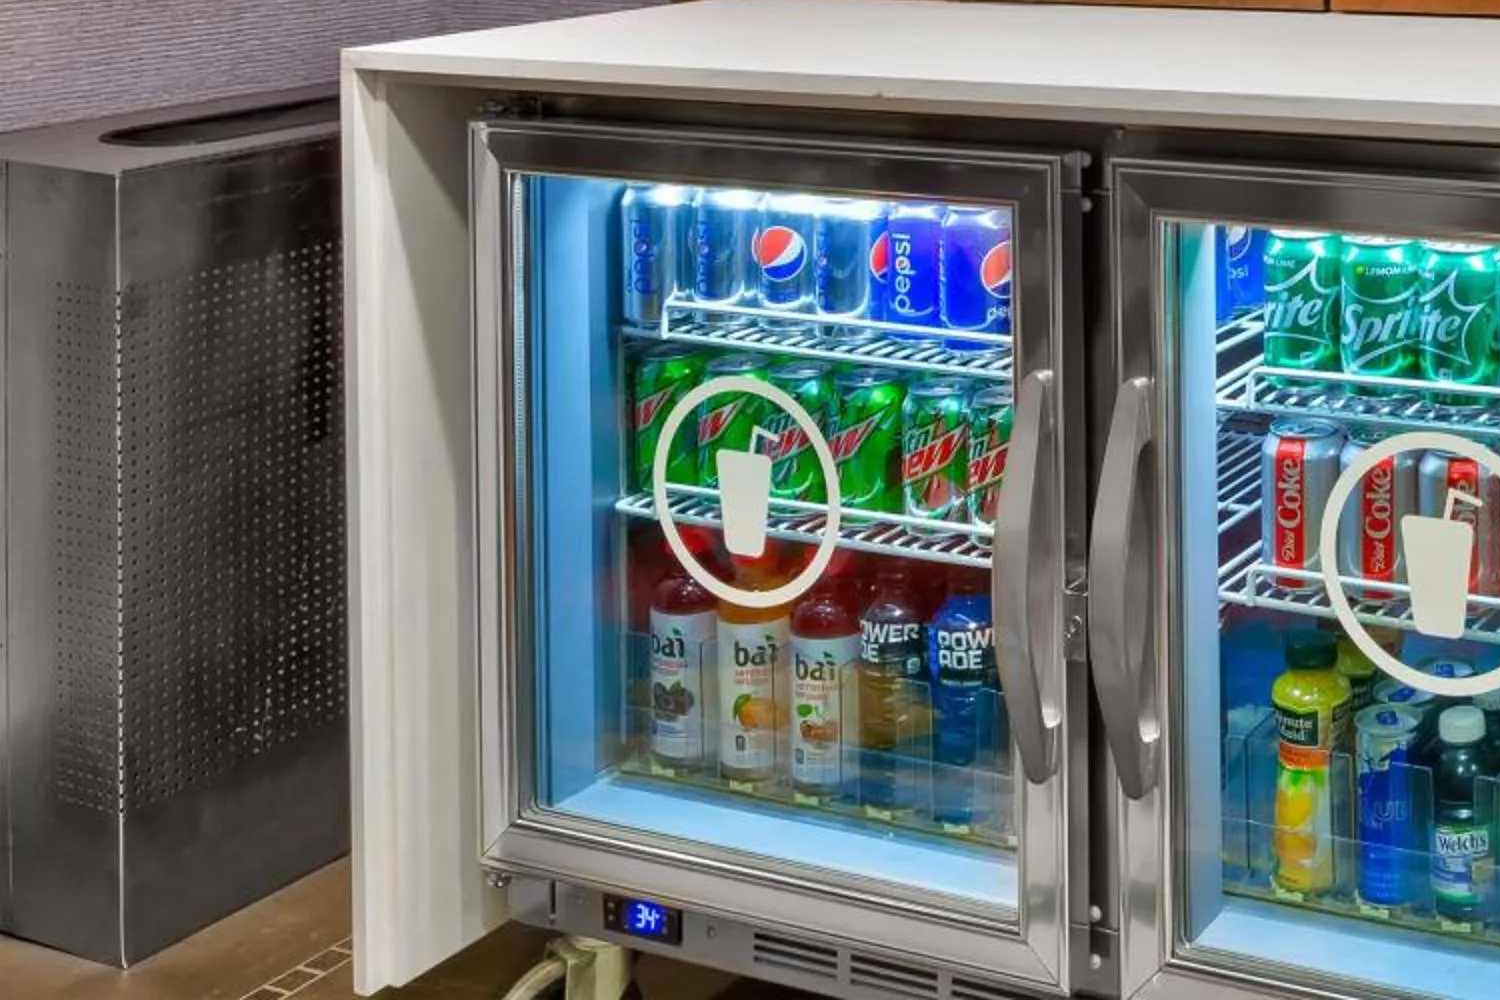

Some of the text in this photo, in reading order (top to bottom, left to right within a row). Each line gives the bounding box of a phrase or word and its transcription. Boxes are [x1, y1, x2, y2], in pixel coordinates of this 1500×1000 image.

[892, 232, 917, 314] pepsi
[1277, 458, 1301, 529] Coke
[1365, 467, 1392, 539] Coke
[733, 634, 778, 667] bai
[795, 650, 836, 681] bai
